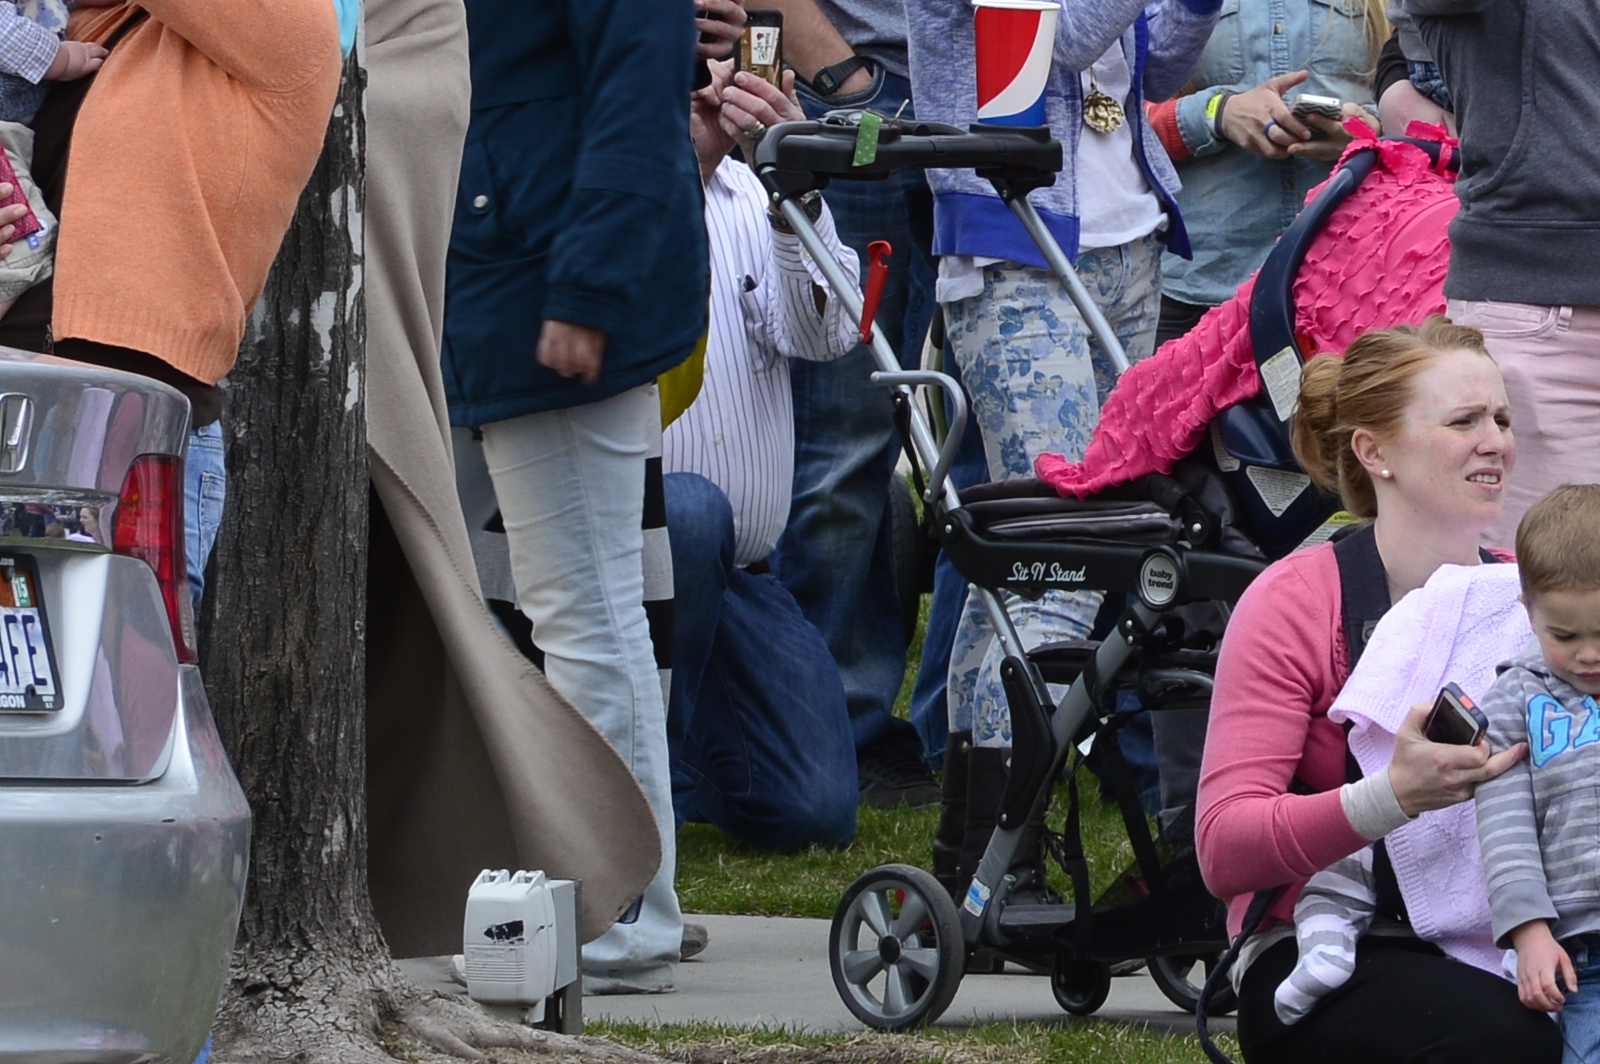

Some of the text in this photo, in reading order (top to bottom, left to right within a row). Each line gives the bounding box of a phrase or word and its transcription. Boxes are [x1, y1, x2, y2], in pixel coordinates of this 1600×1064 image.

[1007, 561, 1029, 581] Sit
[1045, 561, 1087, 582] Stand
[1150, 568, 1174, 581] baby
[1148, 578, 1174, 590] trend
[0, 694, 26, 709] GON
